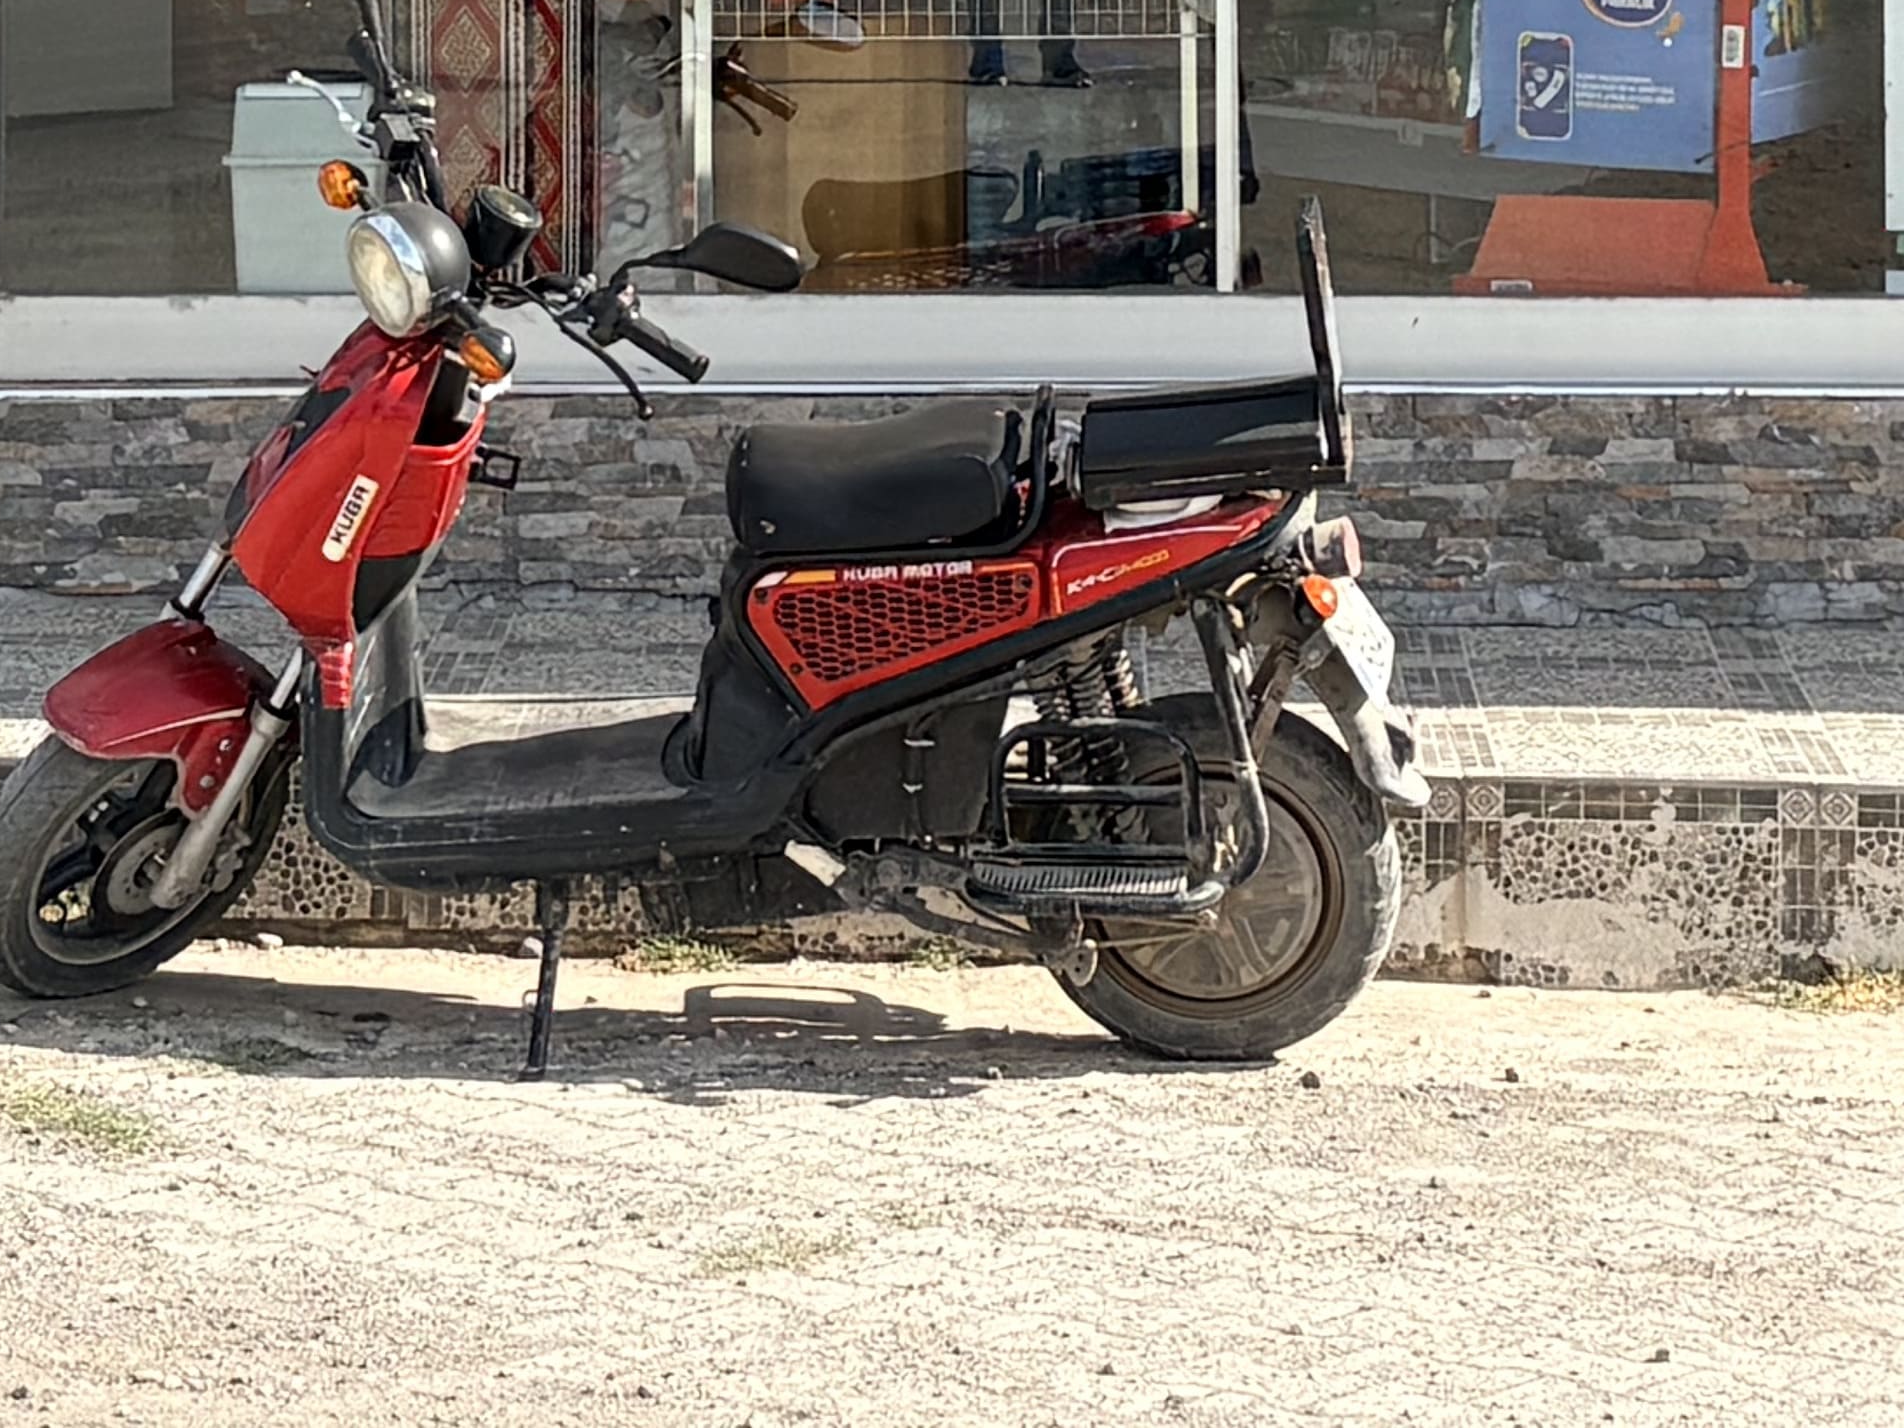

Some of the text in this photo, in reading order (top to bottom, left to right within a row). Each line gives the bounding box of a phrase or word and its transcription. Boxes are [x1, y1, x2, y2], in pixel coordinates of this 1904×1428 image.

[329, 484, 370, 545] KUBA
[842, 559, 973, 581] KUBA MOTOR
